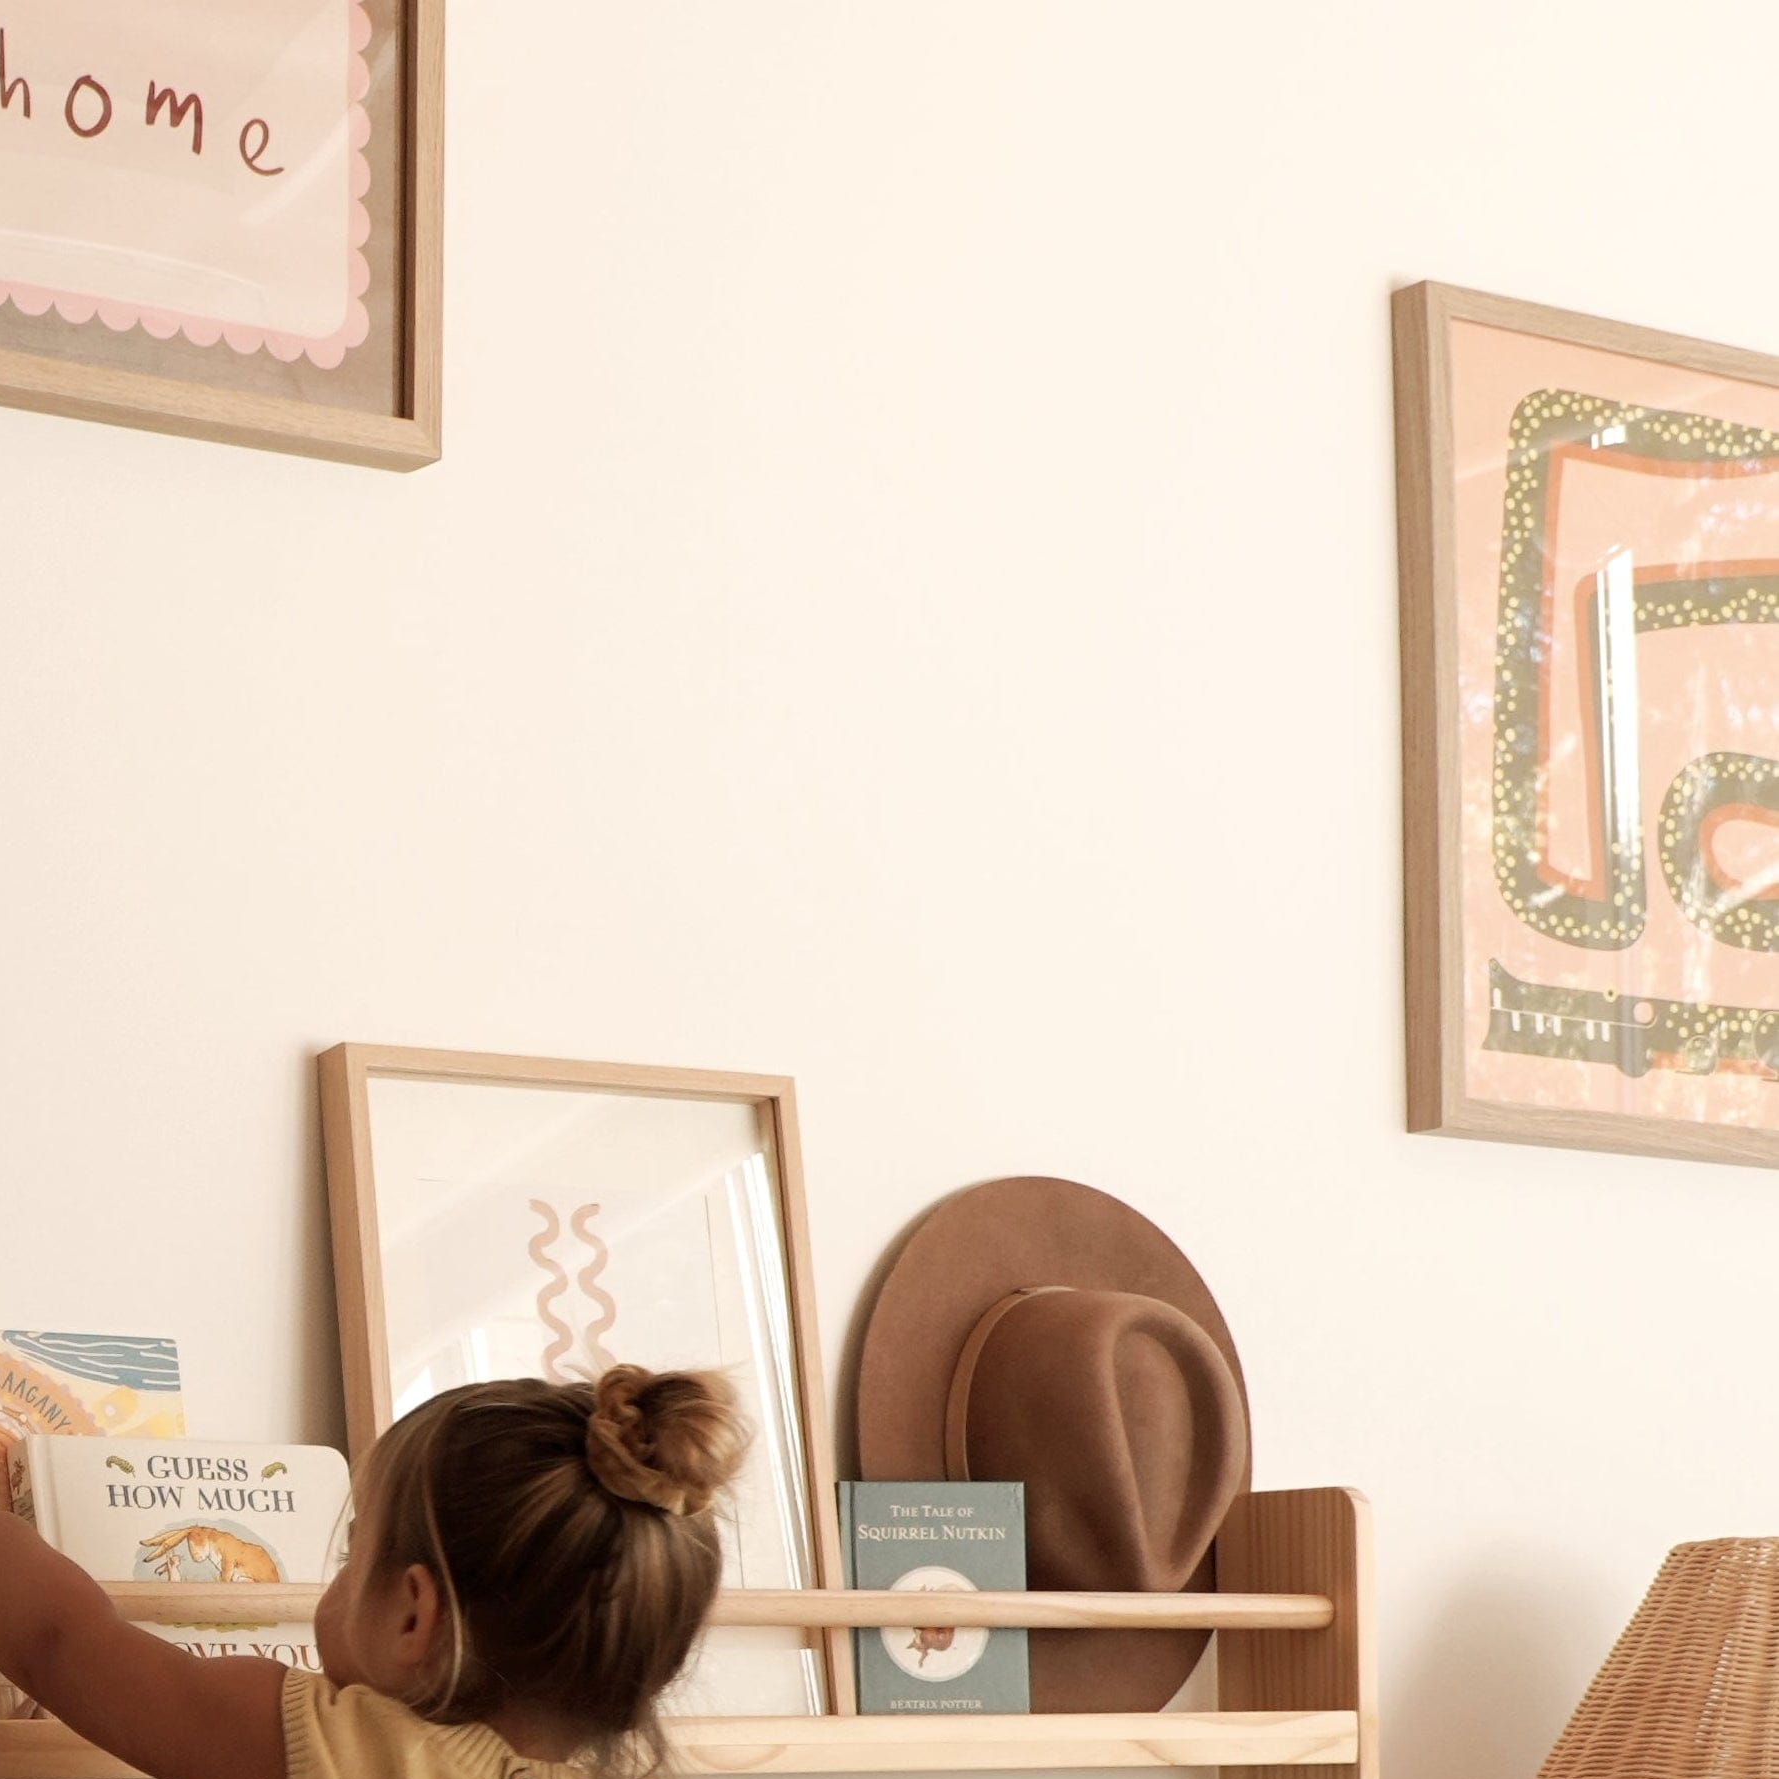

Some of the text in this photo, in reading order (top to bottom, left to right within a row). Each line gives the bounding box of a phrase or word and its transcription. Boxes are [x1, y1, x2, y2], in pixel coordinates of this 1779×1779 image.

[147, 1455, 249, 1482] GUESS
[105, 1484, 297, 1513] HOW MUCH
